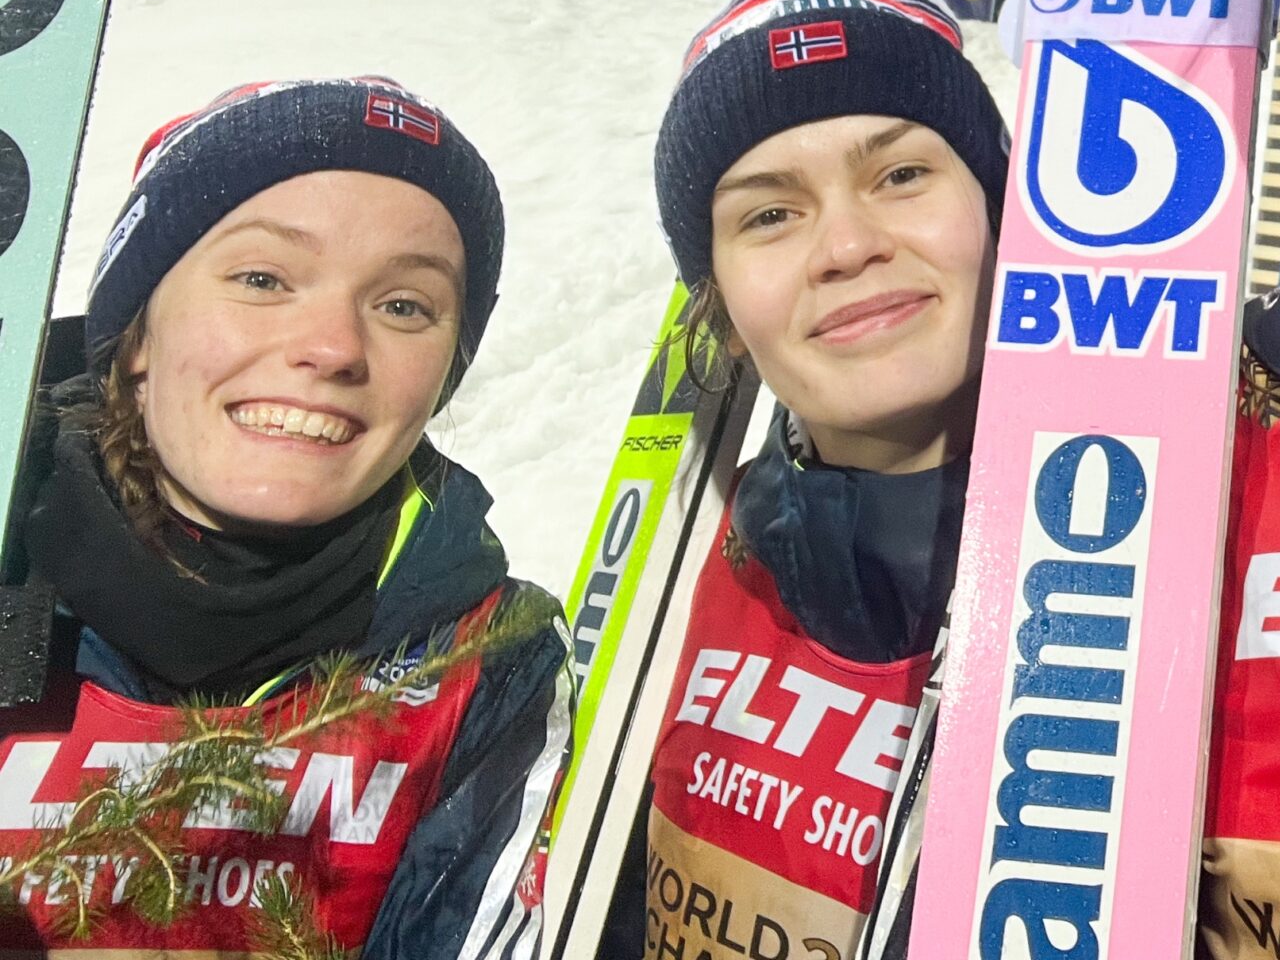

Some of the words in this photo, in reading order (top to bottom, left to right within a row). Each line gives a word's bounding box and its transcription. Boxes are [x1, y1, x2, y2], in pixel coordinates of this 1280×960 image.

[997, 270, 1218, 352] BWT
[621, 434, 682, 451] FISCHER
[675, 648, 916, 793] ELTE
[979, 434, 1147, 960] ammo
[0, 740, 408, 844] LTEN
[686, 751, 803, 831] SAFETY
[803, 795, 883, 868] SHO
